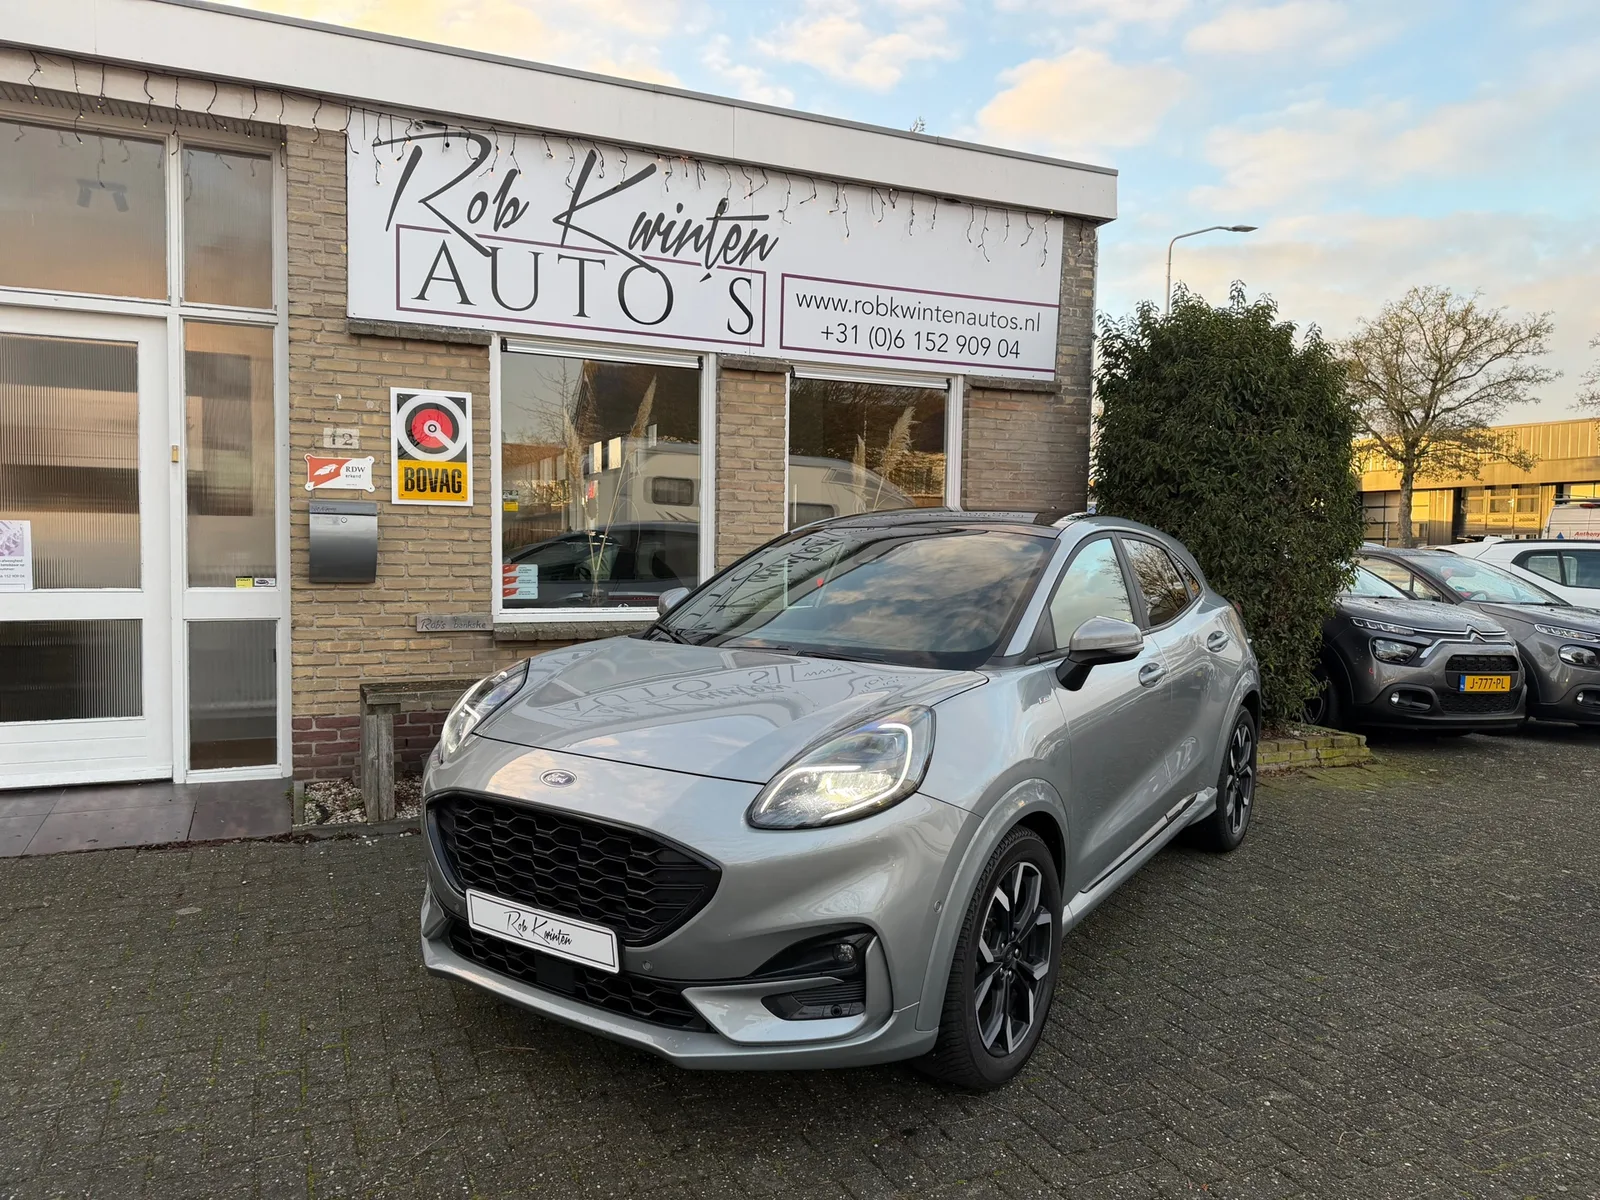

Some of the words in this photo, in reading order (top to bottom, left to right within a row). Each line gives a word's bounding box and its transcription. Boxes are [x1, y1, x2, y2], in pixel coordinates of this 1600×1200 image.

[372, 131, 530, 257] Rob
[552, 149, 779, 273] Kwinten
[796, 293, 1041, 332] www.robkwintenautos.nl
[821, 323, 859, 345] +31
[868, 326, 905, 351] (0)6
[914, 331, 949, 353] 152
[956, 335, 991, 357] 909
[997, 339, 1020, 359] 04
[330, 431, 353, 446] 12
[404, 466, 462, 494] BOVAG
[1470, 677, 1506, 689] J-777-PL
[503, 910, 528, 938] Rob
[531, 916, 573, 945] Kwinten
